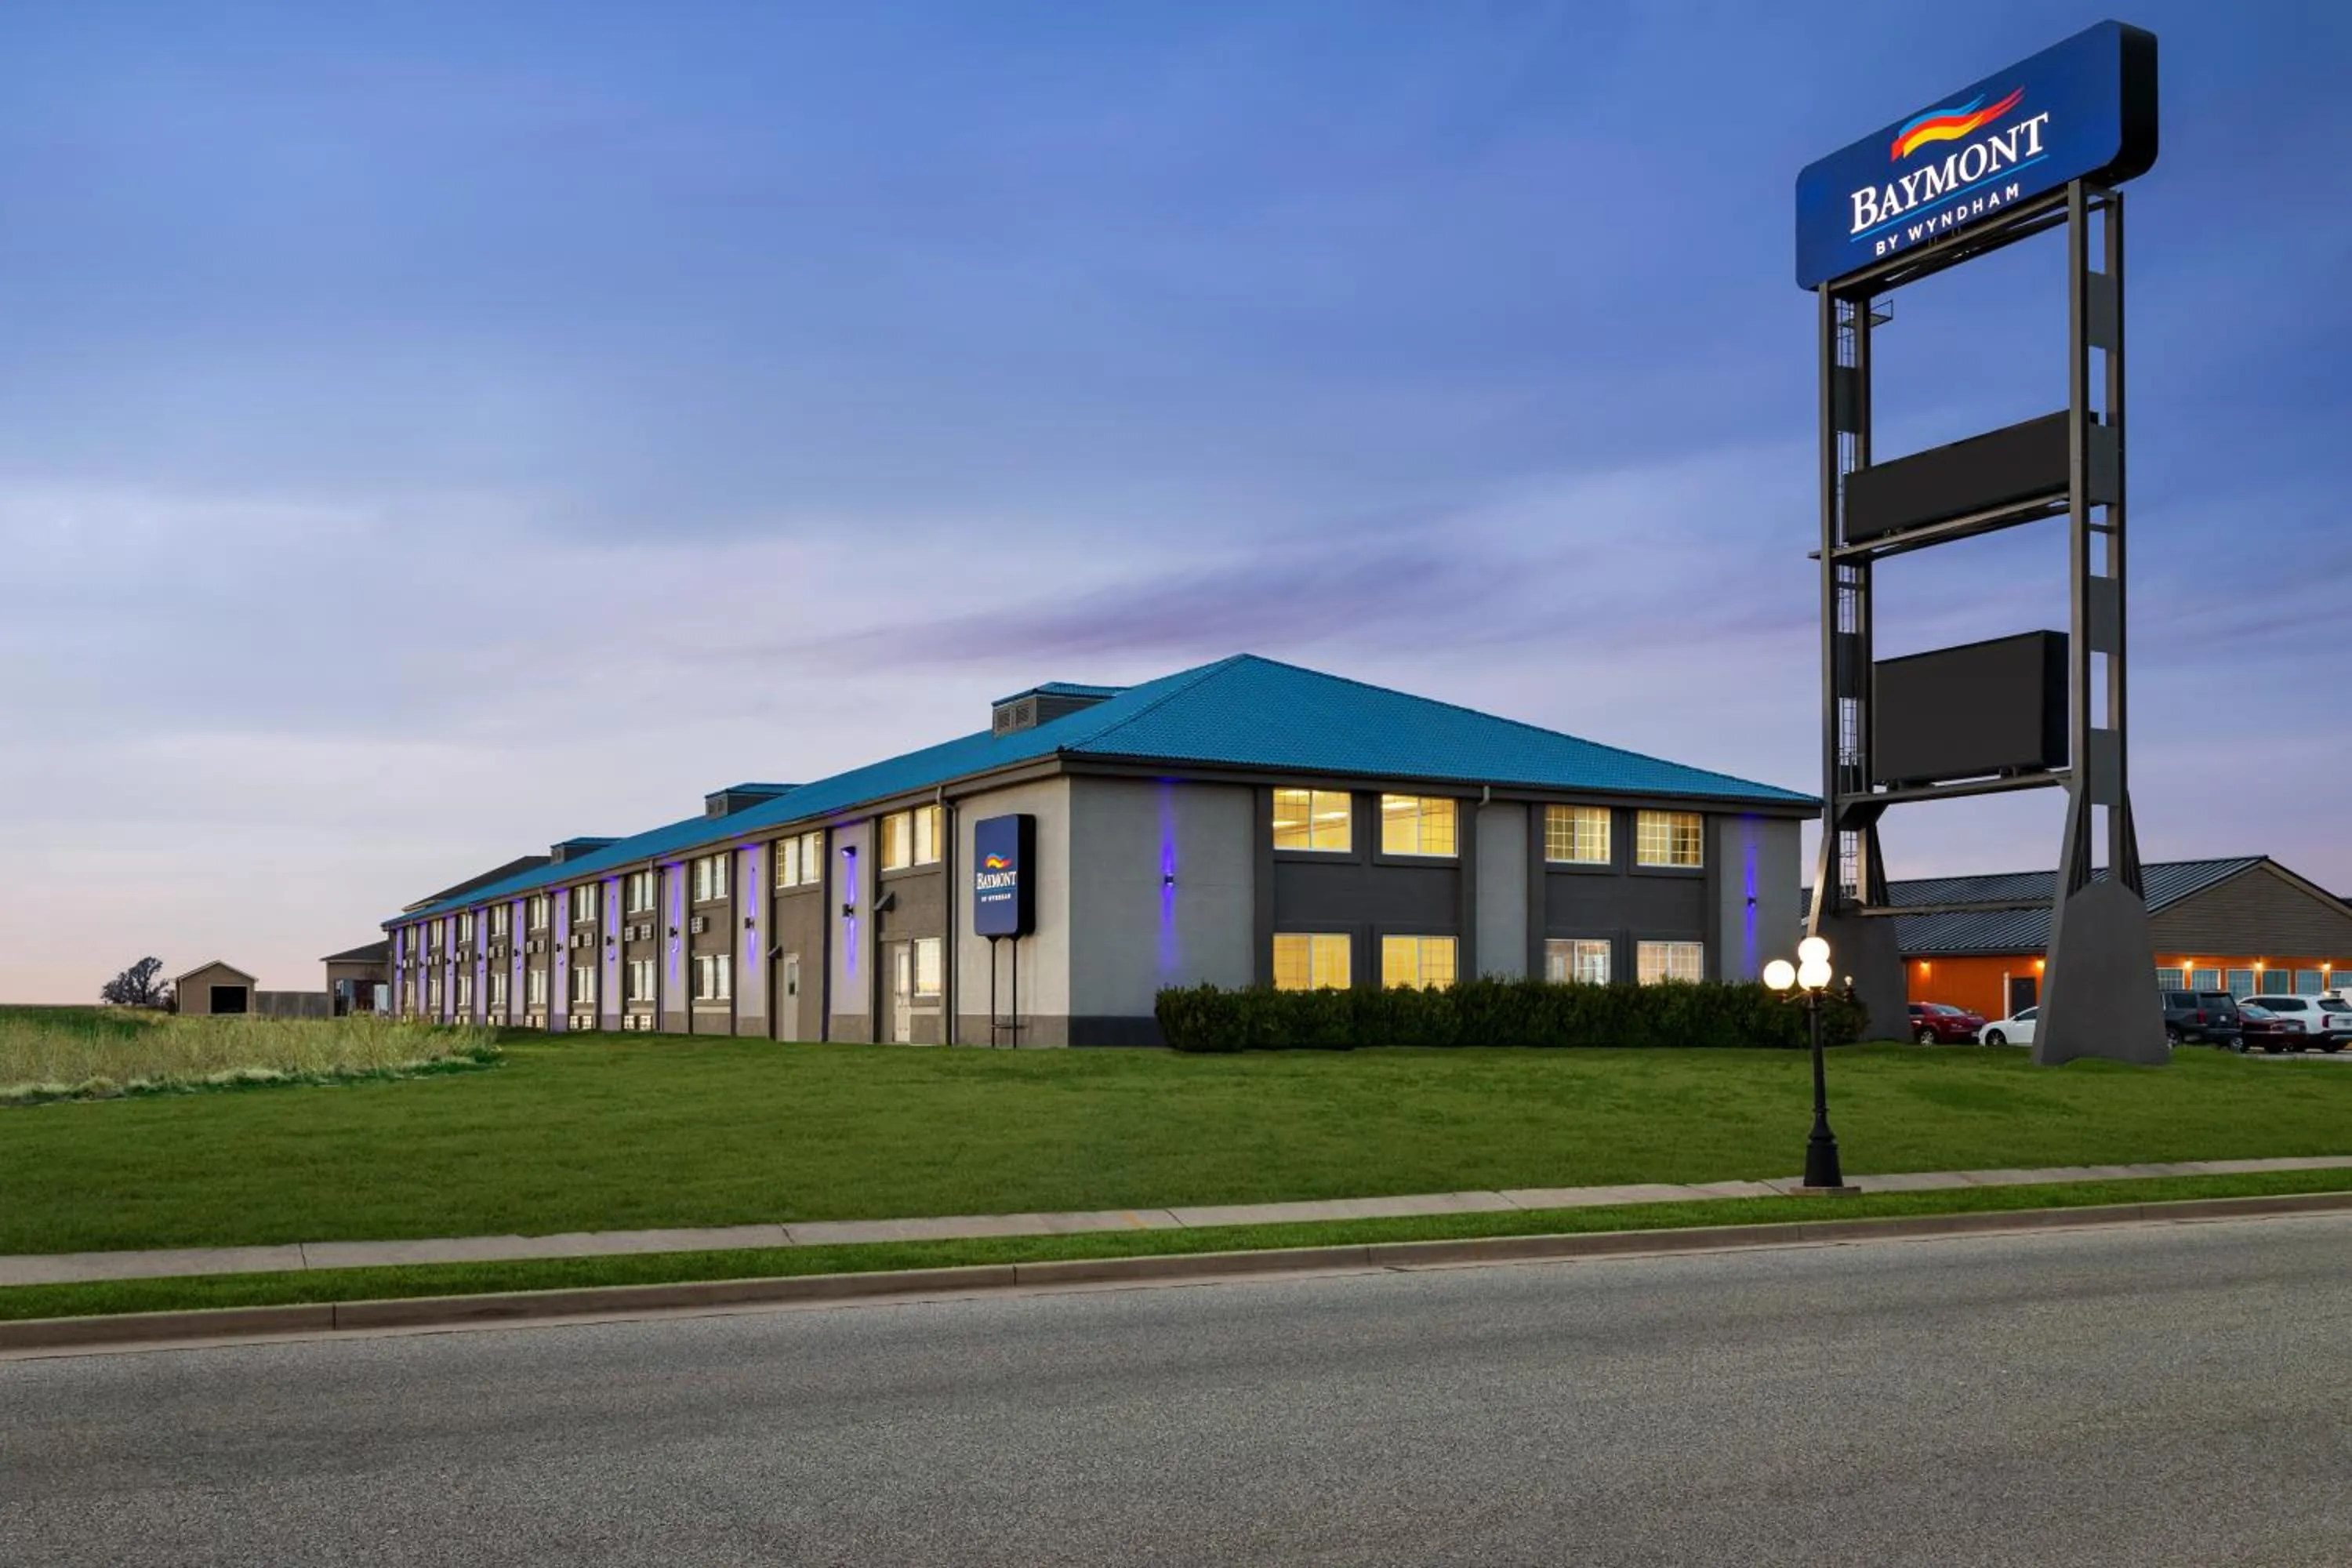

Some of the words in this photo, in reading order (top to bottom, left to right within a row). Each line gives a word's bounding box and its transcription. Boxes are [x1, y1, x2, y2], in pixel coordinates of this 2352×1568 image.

[1849, 111, 2049, 234] BAYMONT
[1876, 234, 1898, 256] BY
[1908, 183, 2020, 241] WYNDHAM
